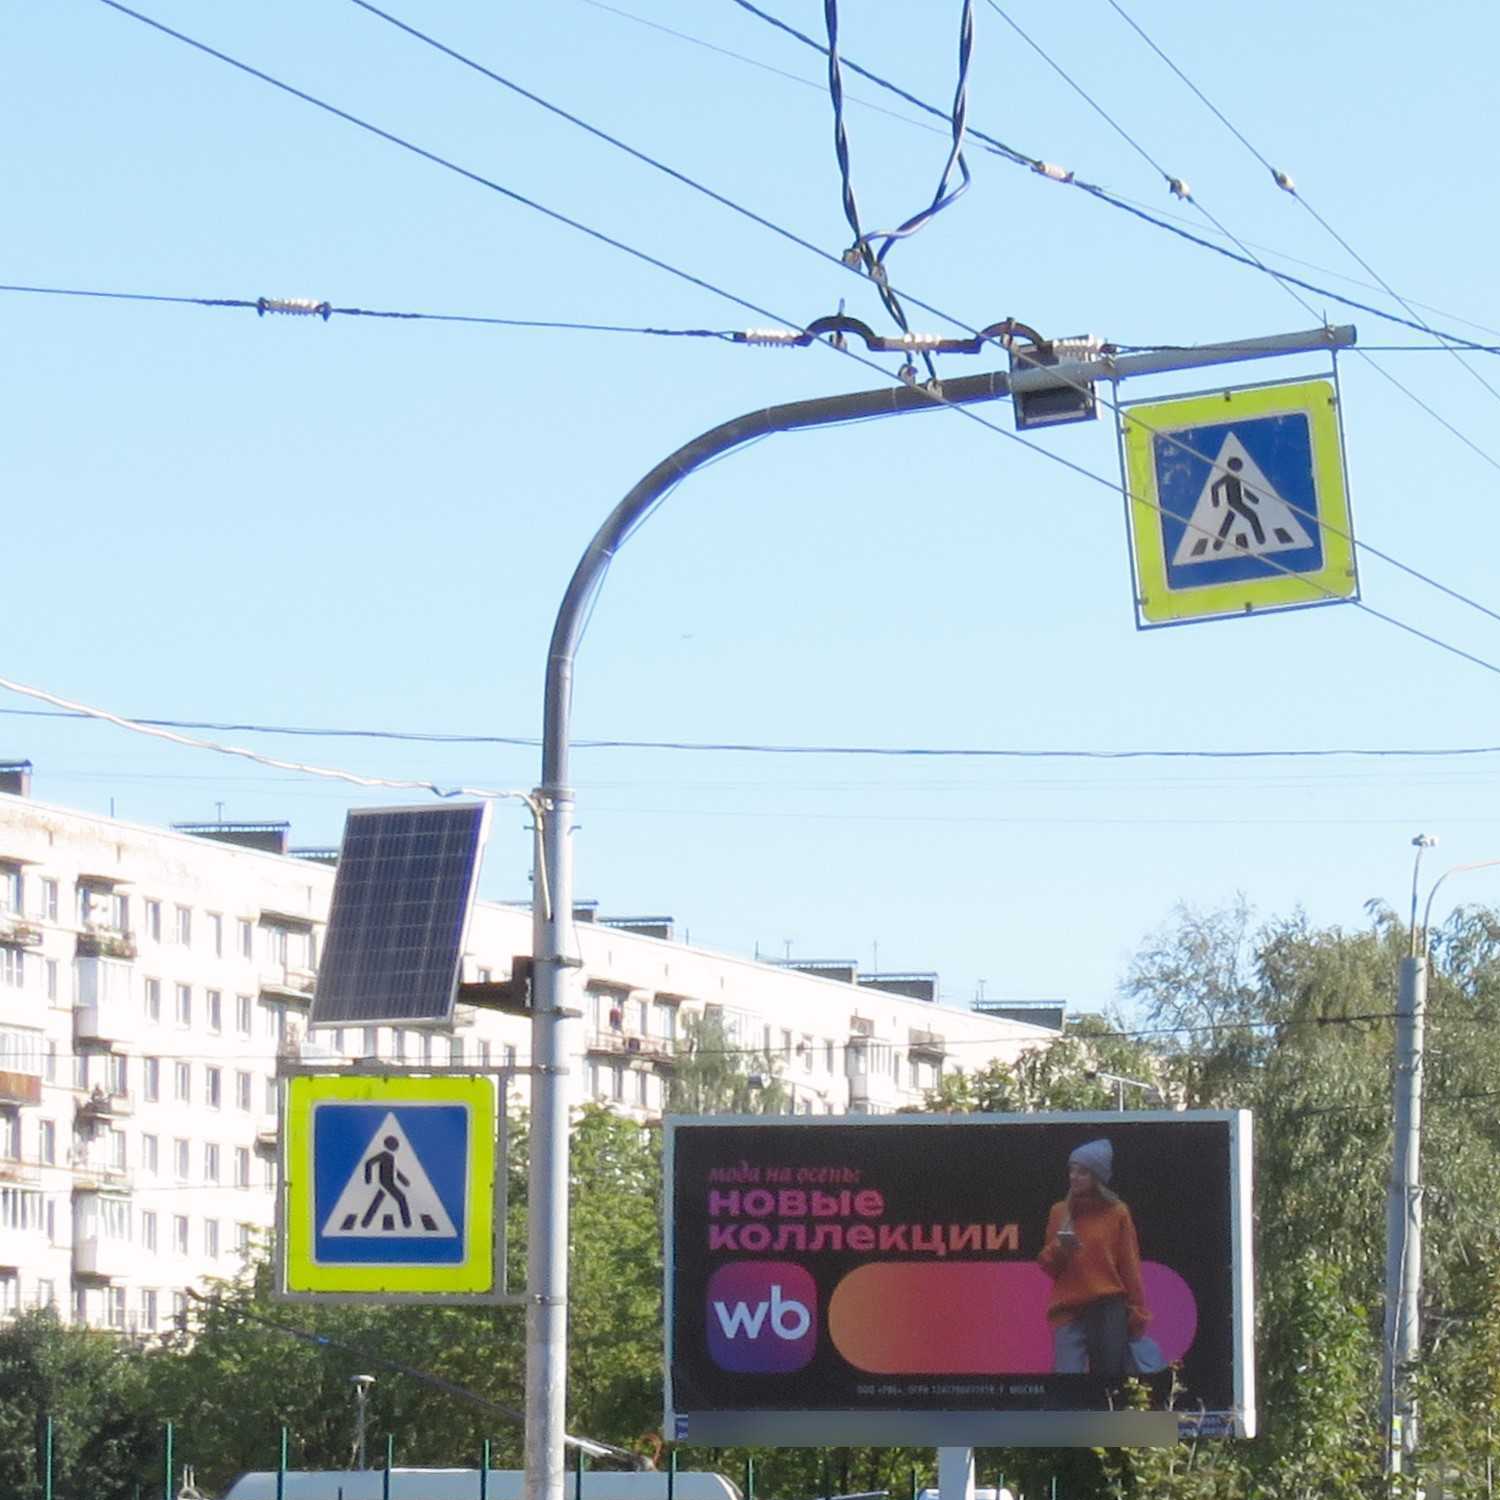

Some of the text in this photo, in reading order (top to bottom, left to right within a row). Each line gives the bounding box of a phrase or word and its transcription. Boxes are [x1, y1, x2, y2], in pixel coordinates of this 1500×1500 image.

[708, 1189, 885, 1217] новые
[708, 1223, 1019, 1255] коллекции
[713, 1285, 810, 1339] wb
